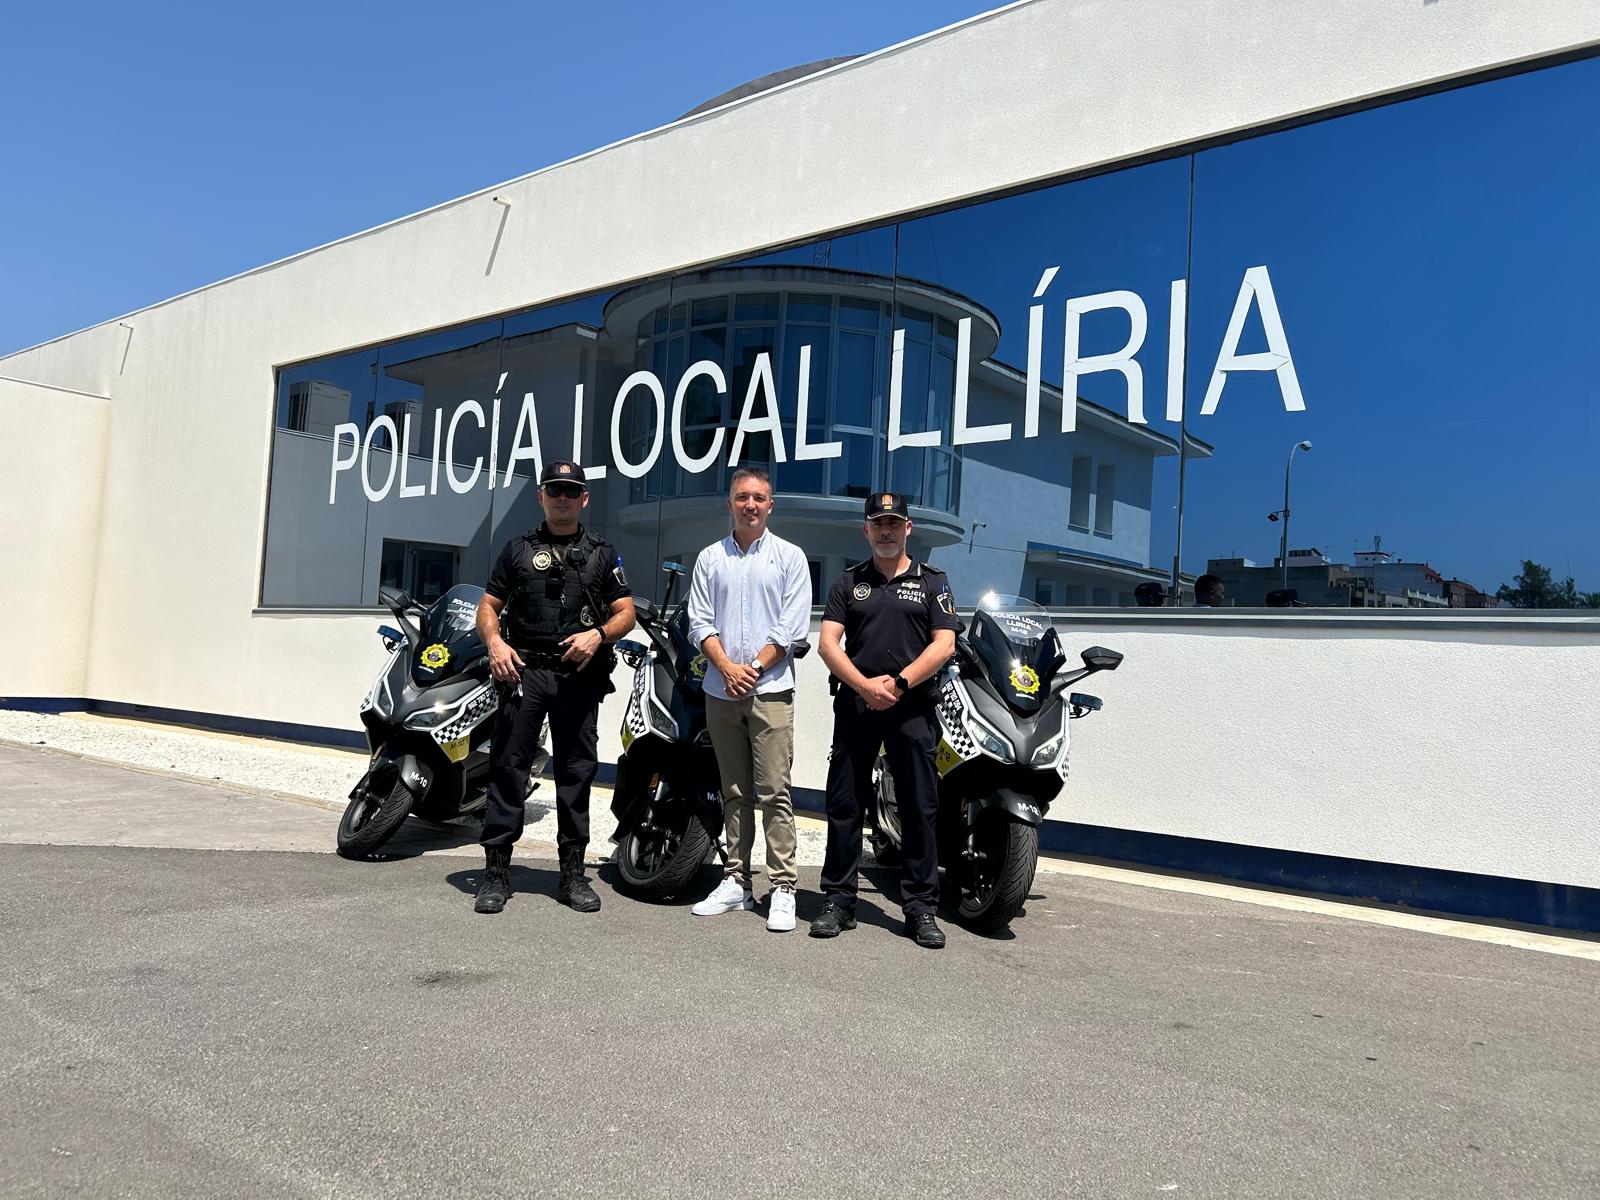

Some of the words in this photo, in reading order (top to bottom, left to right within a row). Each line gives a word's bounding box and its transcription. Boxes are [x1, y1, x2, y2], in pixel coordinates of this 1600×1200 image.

[329, 372, 544, 505] POLICÍA
[573, 345, 843, 480] LOCAL
[887, 265, 1306, 452] LLÍRIA
[896, 589, 926, 599] POLICIA
[898, 595, 922, 604] LOCAL
[991, 611, 1021, 621] POLICIA
[1022, 616, 1043, 630] LOCAL
[410, 771, 428, 788] M-10
[1017, 802, 1040, 816] M-12
